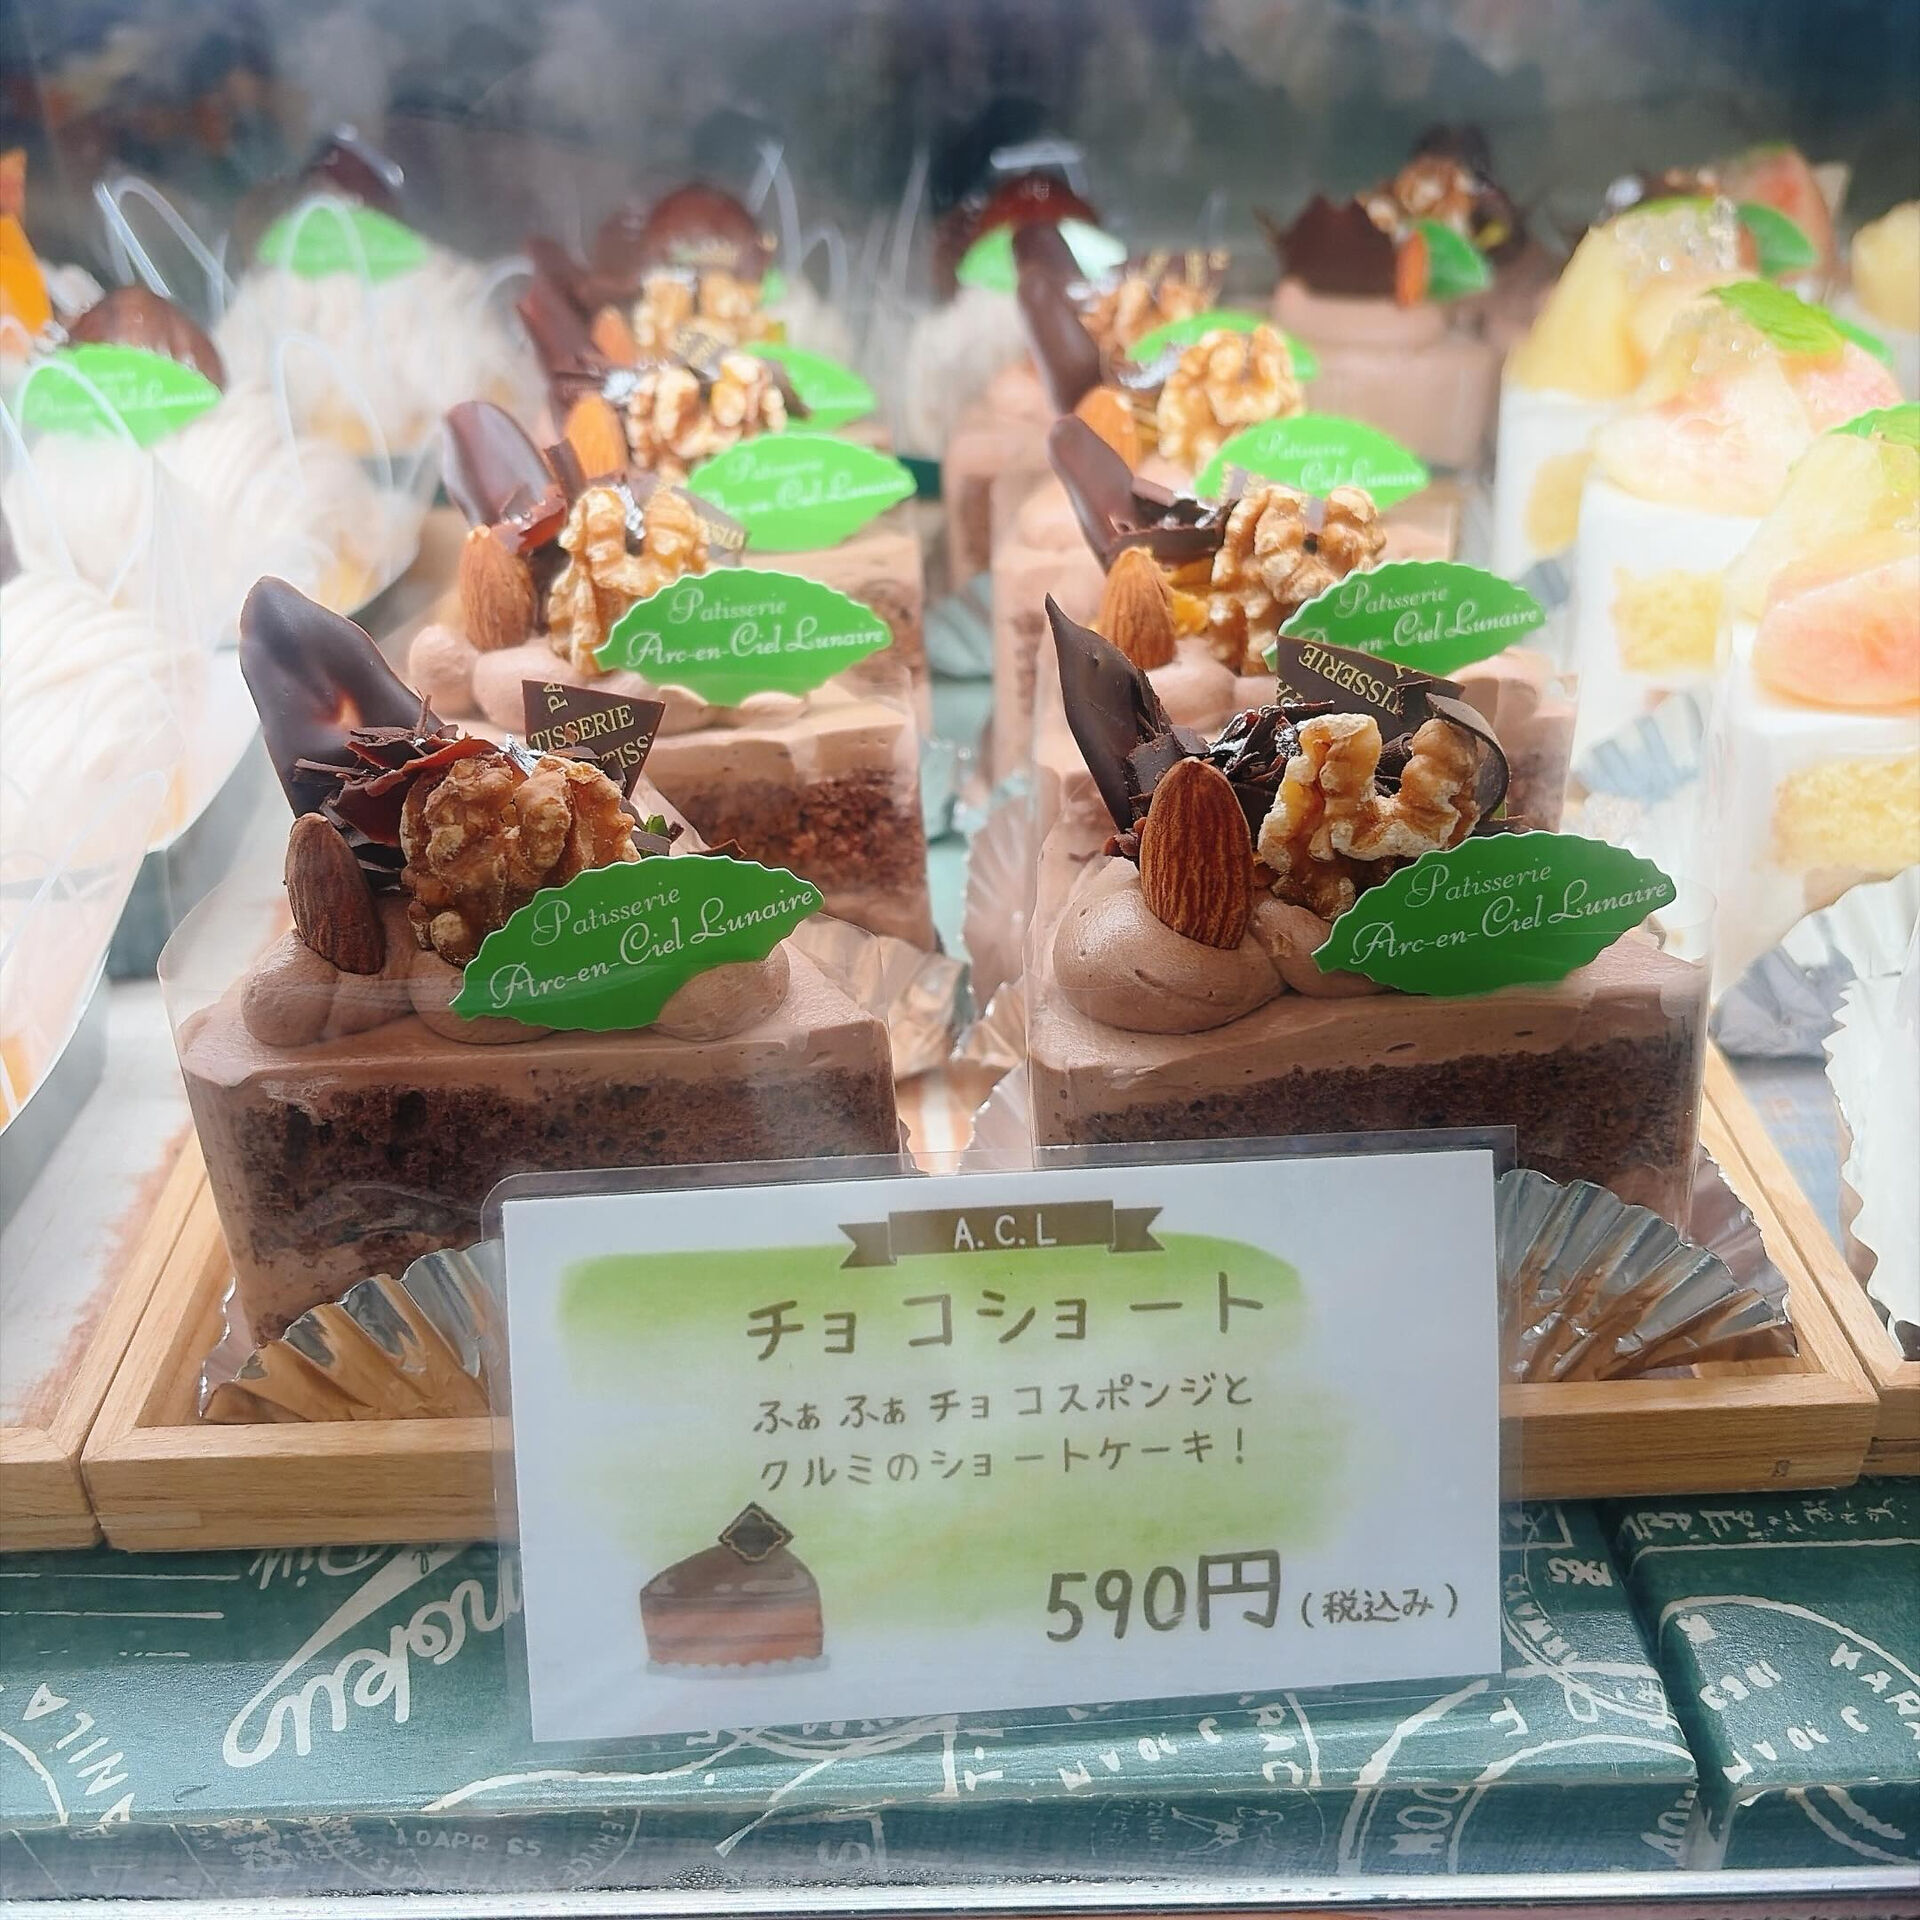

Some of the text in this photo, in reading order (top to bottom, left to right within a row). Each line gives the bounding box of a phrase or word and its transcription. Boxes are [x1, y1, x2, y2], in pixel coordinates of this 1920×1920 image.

[668, 587, 787, 624] Patisserie
[1334, 580, 1448, 618] Patisserie
[1444, 600, 1537, 636] Lunaire
[785, 616, 885, 653] Lunaire
[1404, 858, 1551, 908] Patisserie
[531, 881, 681, 947] Patisserie
[1349, 878, 1669, 965] Arc-en-Ciel Lunaire
[489, 890, 814, 1010] Arc-en-Ciel Lunaire
[954, 1213, 1057, 1249] A.C.L
[746, 1271, 1264, 1361] チョコショート
[1045, 1549, 1283, 1643] 590円
